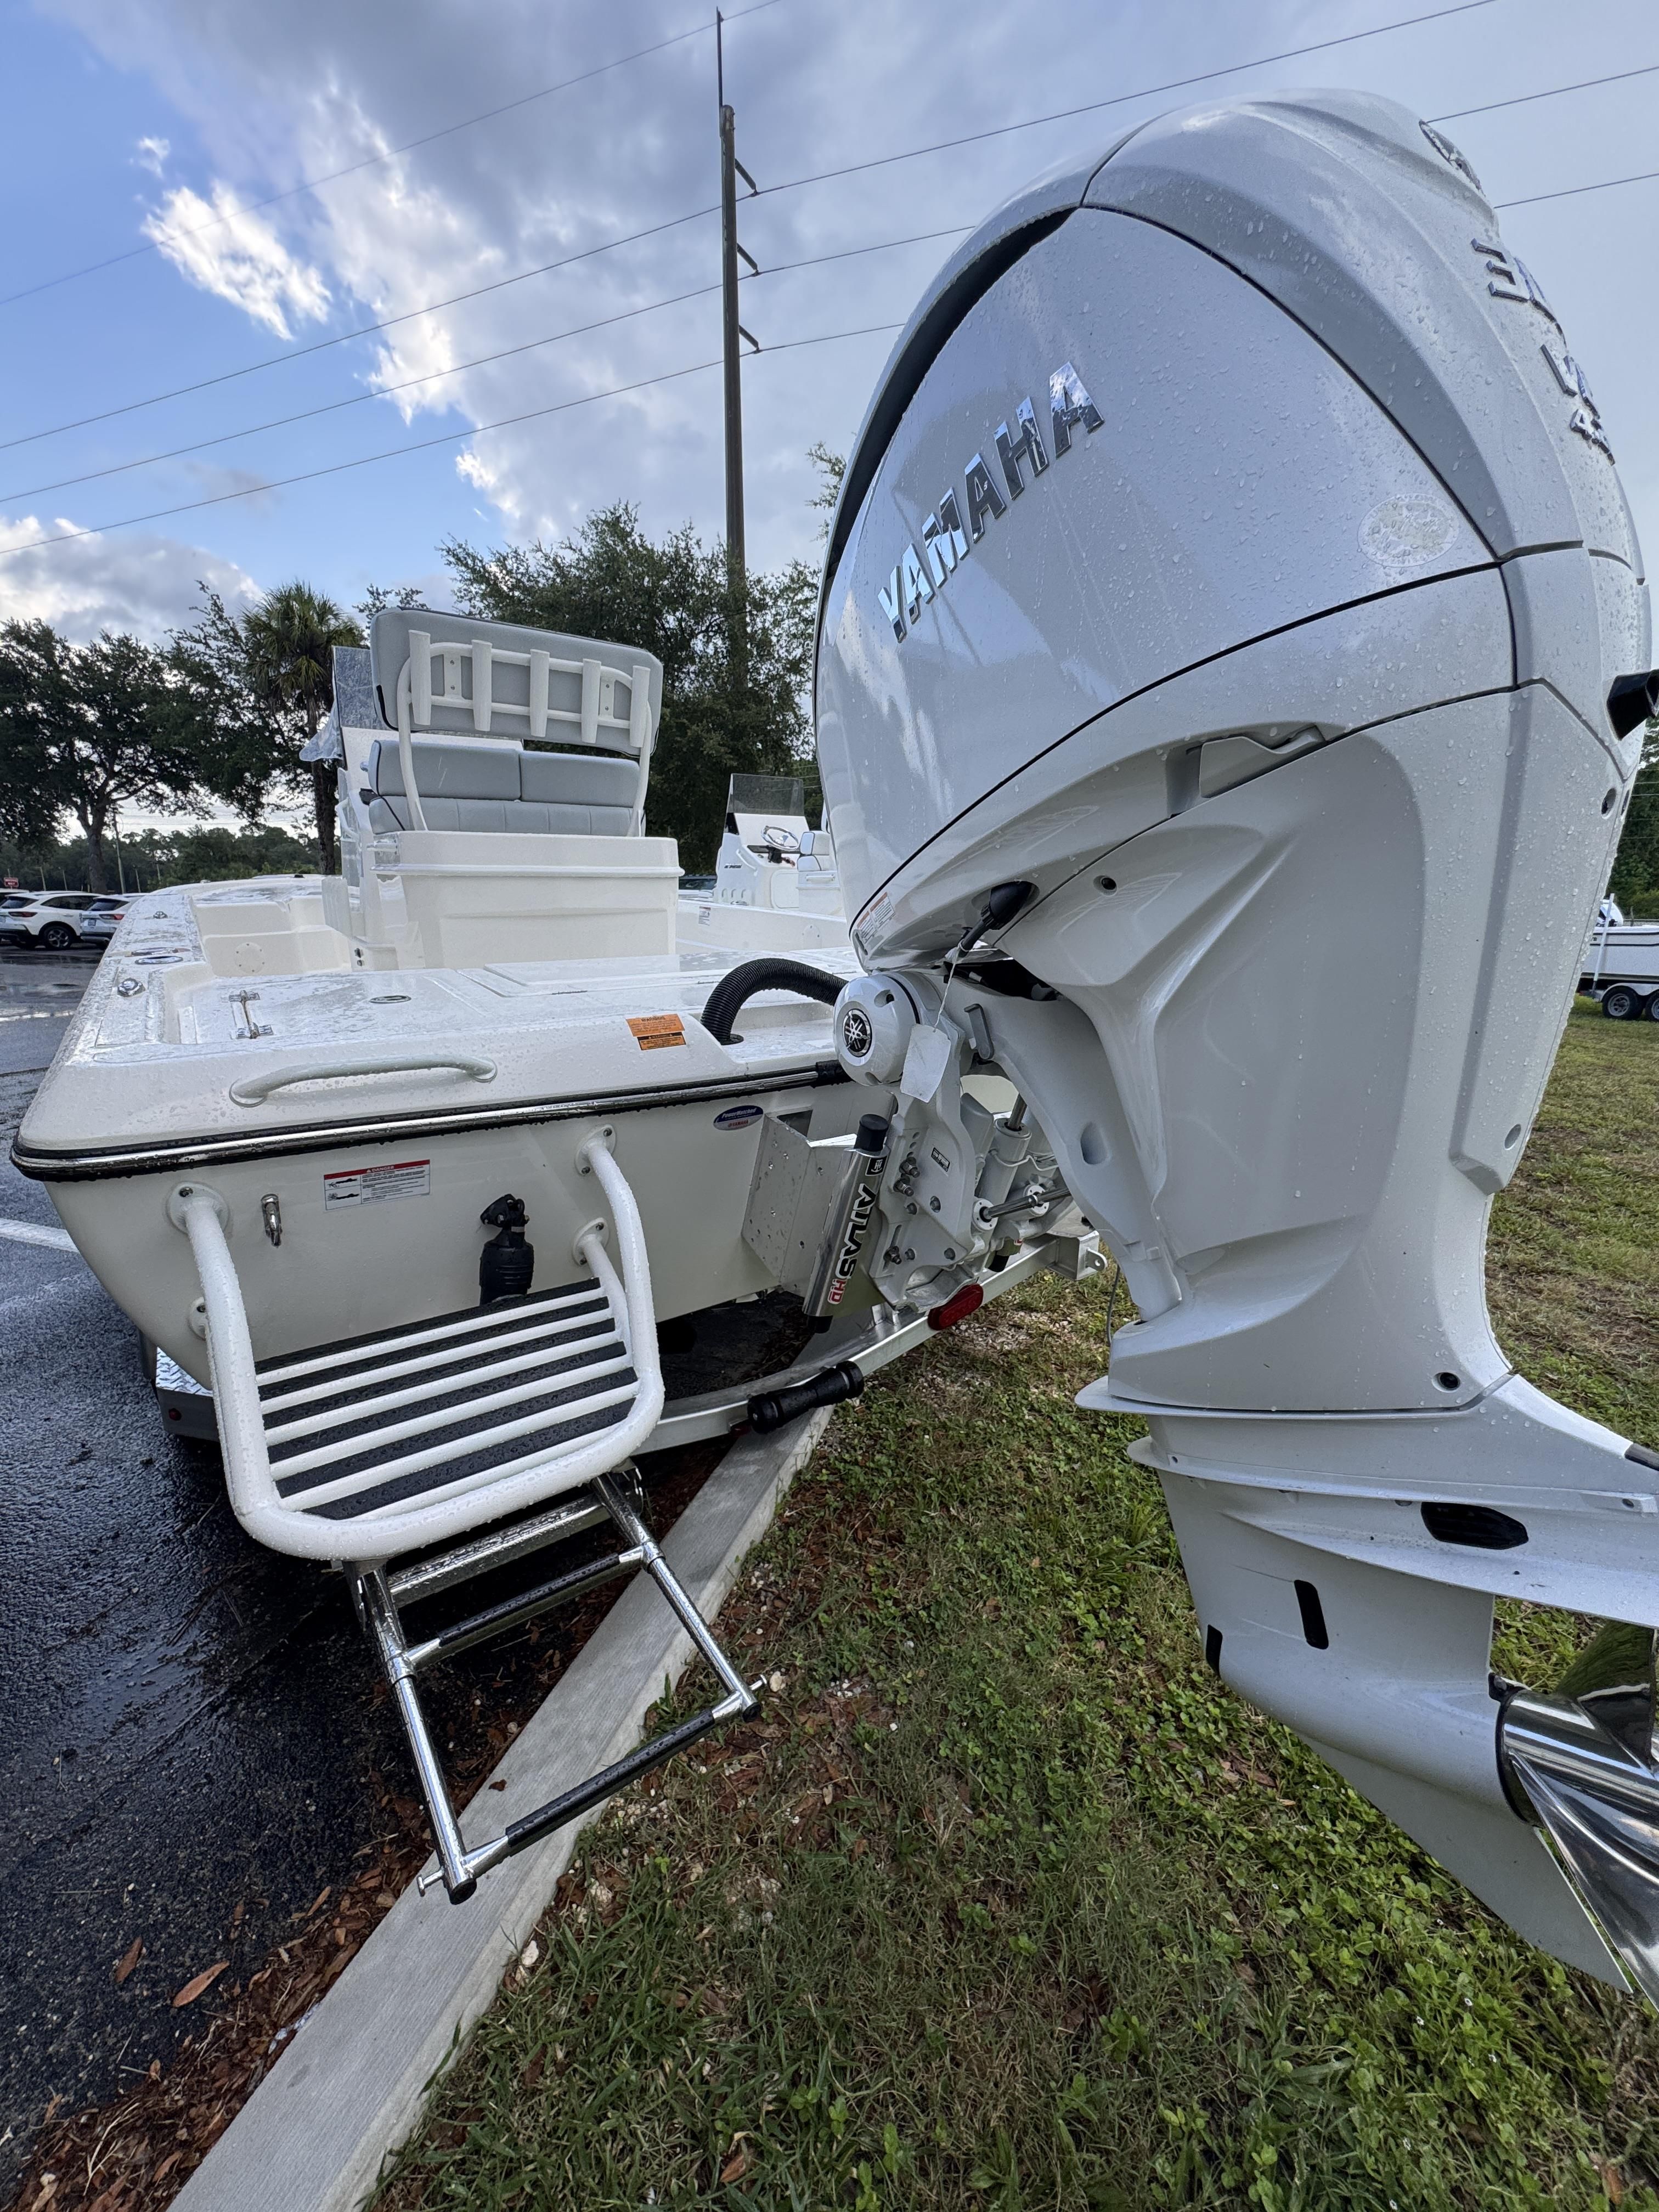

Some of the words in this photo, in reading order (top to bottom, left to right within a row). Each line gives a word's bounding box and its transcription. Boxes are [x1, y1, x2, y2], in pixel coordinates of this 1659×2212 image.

[877, 360, 1105, 644] YAMAHA
[836, 1183, 877, 1279] ATLAS
[827, 1278, 847, 1305] HD
